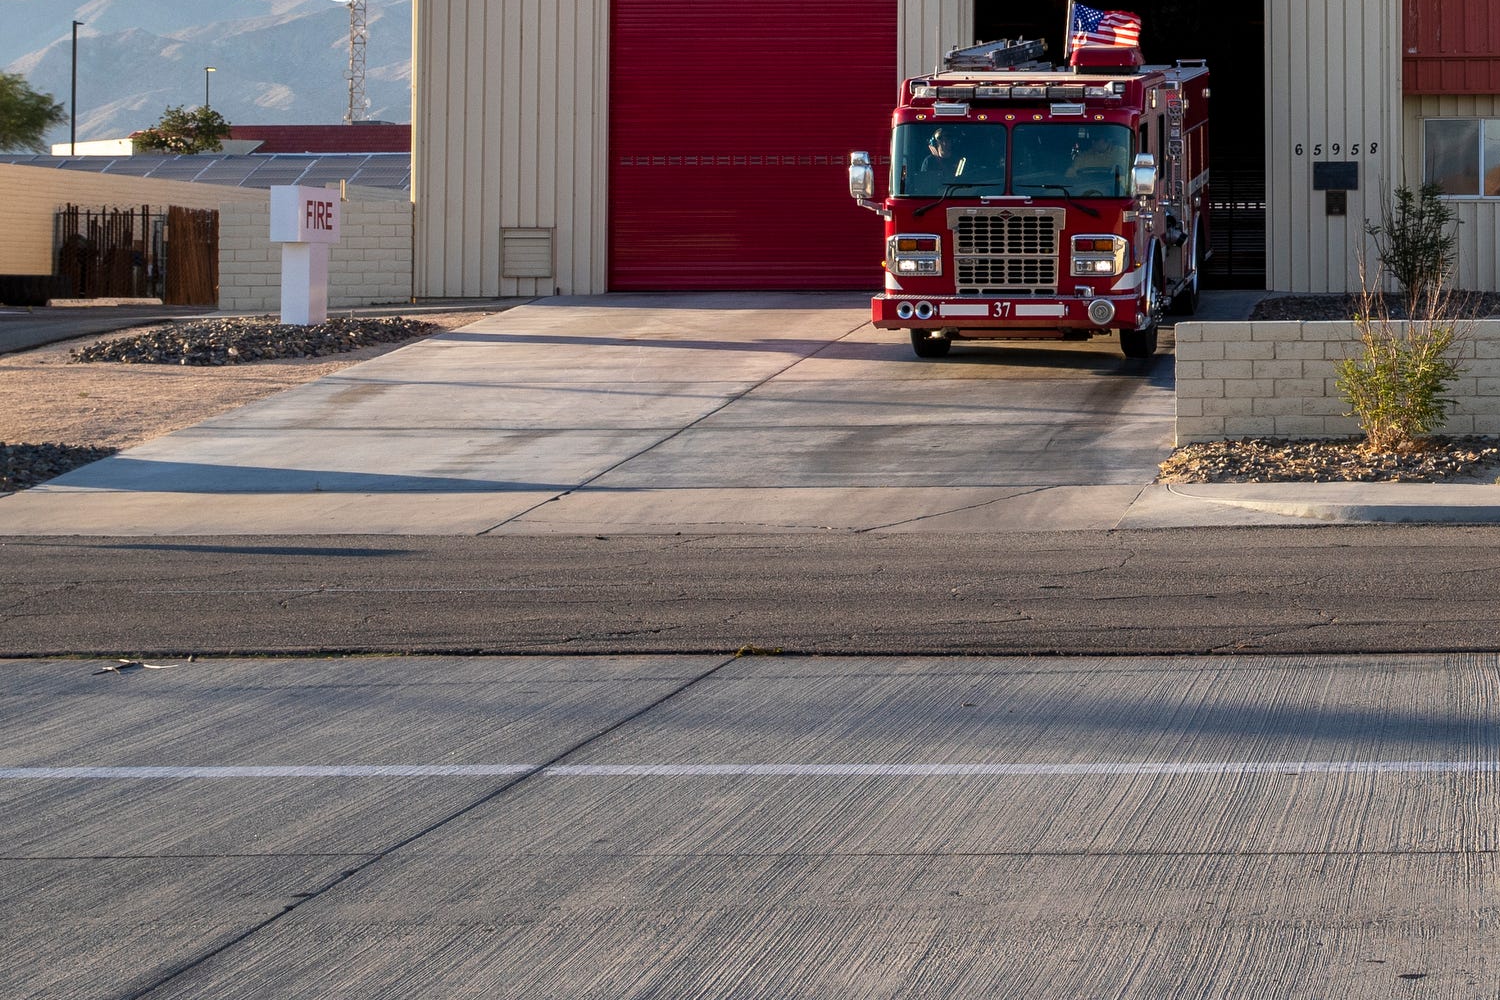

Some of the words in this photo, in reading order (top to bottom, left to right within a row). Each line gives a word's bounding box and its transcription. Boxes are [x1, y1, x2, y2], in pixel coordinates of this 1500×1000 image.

[1295, 142, 1378, 156] 65958
[306, 200, 333, 230] FIRE
[993, 301, 1011, 317] 37
